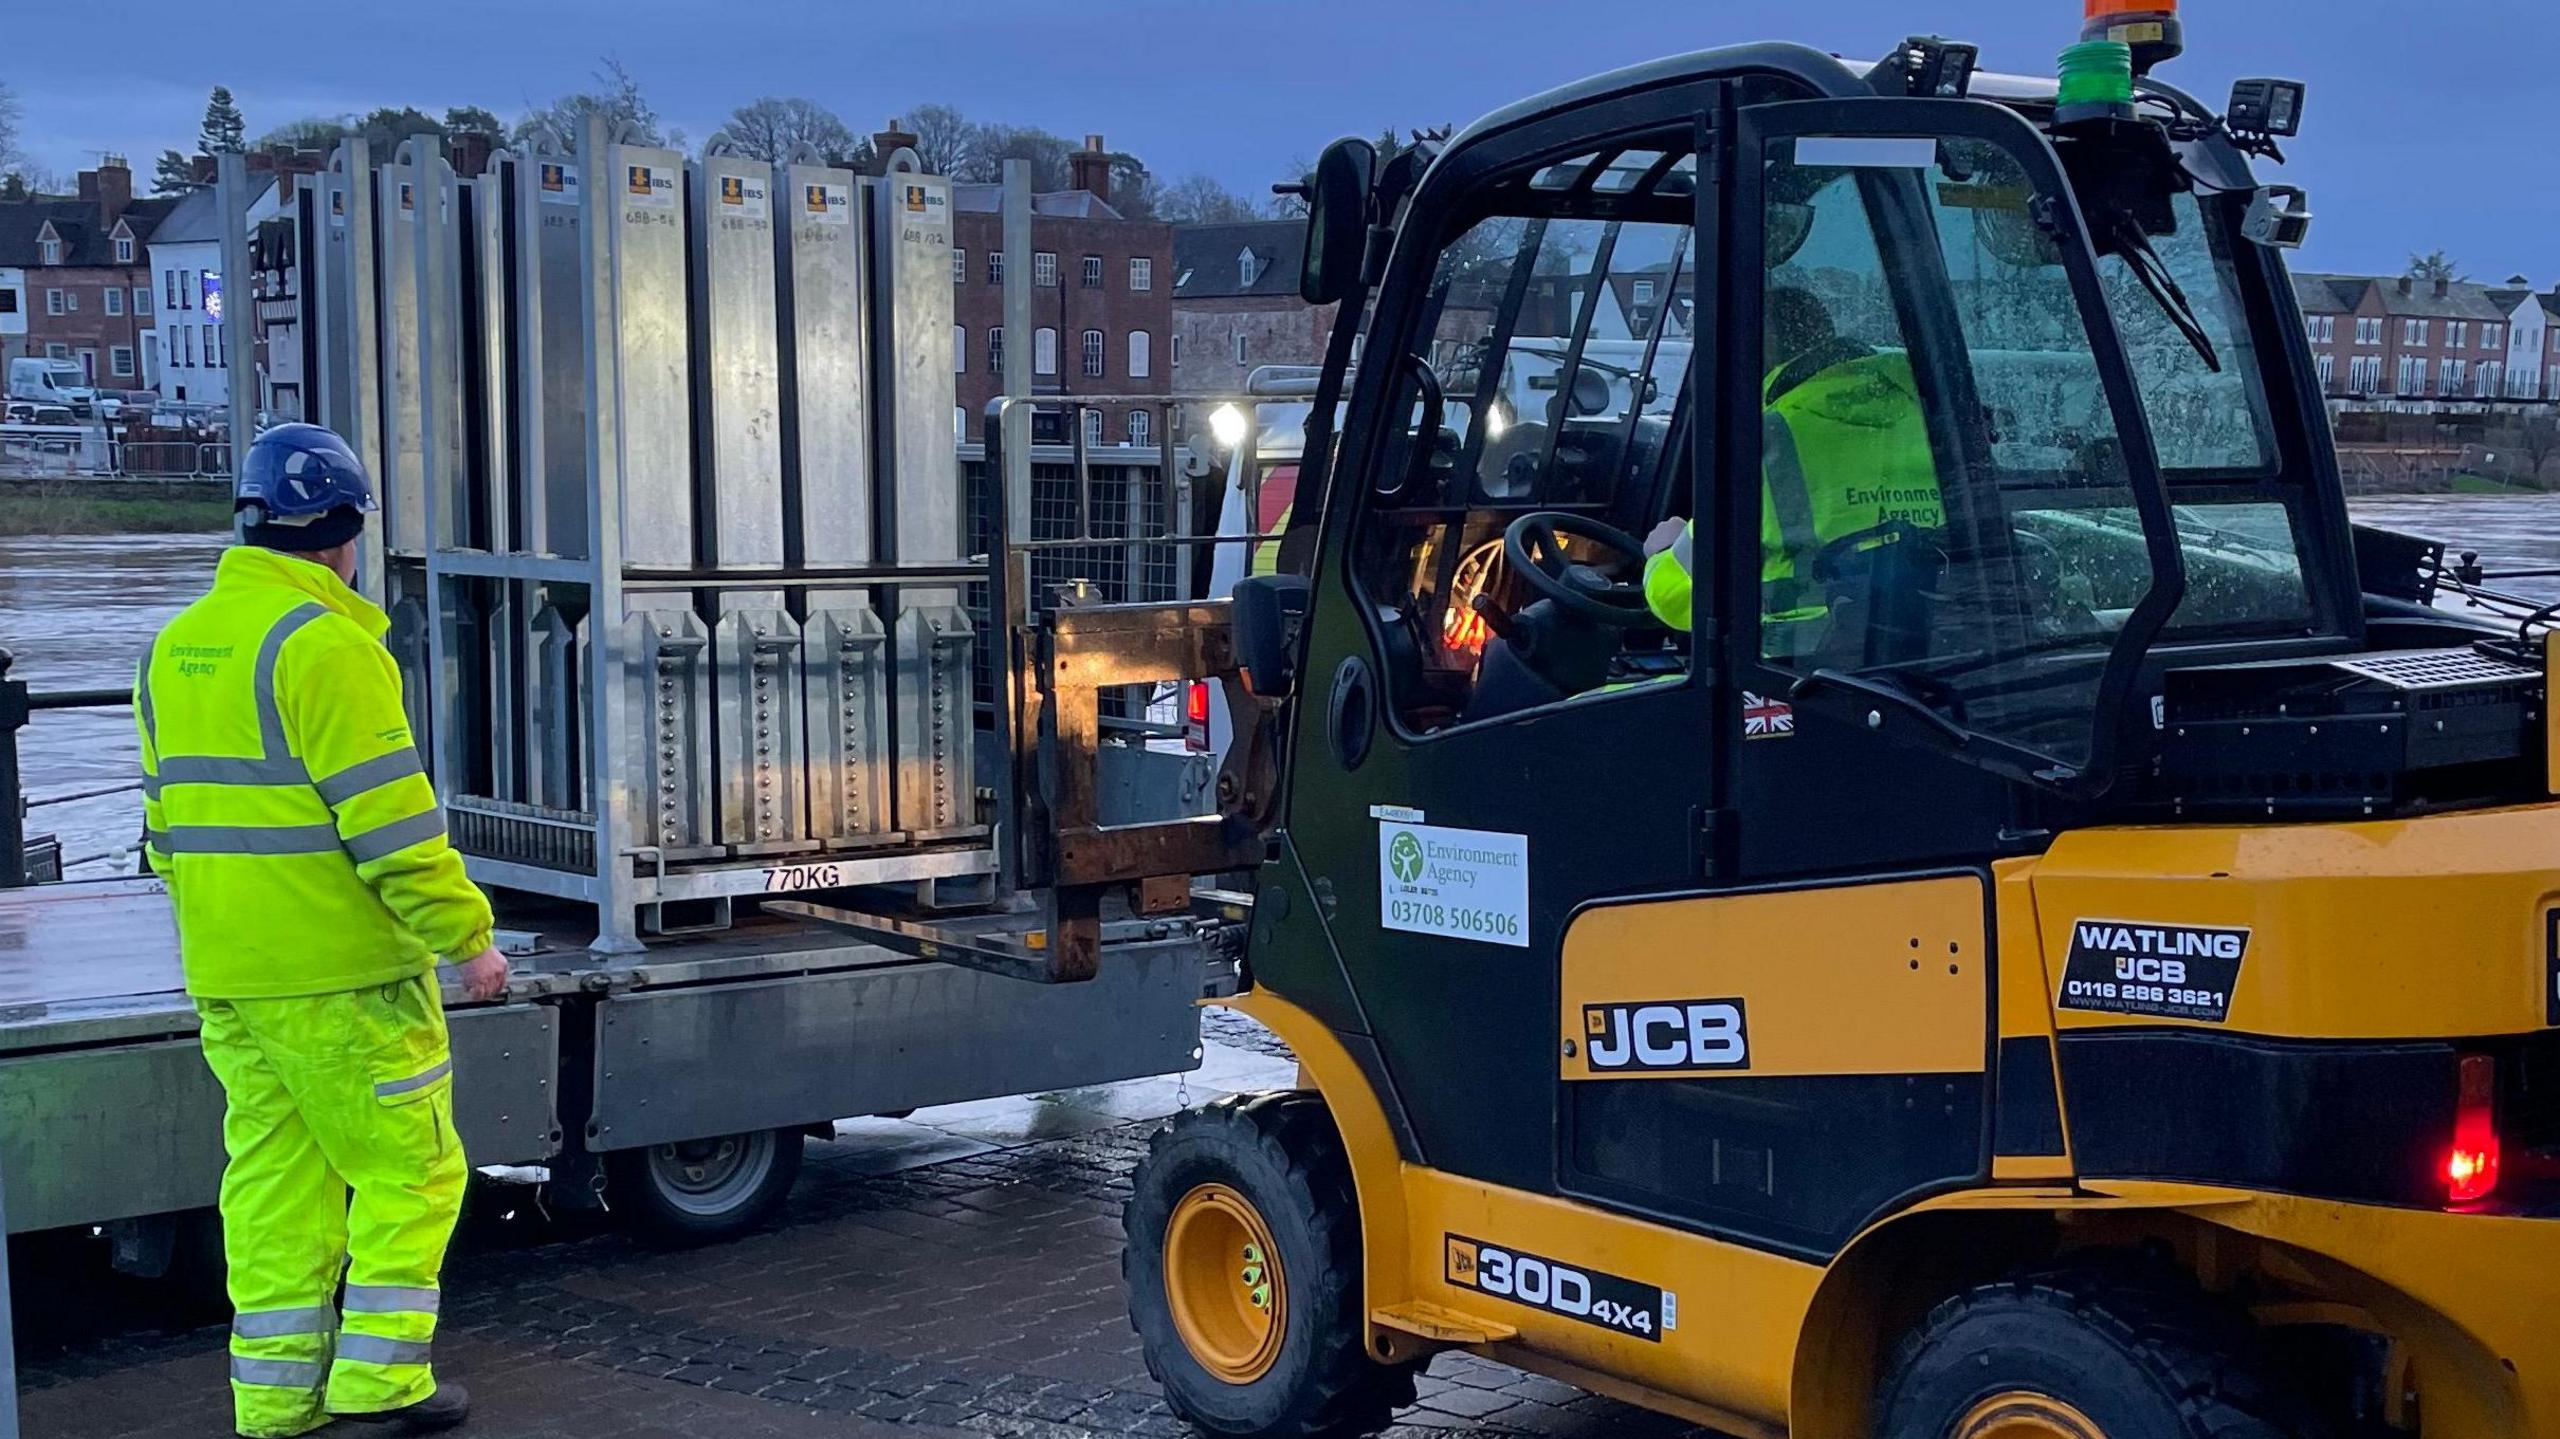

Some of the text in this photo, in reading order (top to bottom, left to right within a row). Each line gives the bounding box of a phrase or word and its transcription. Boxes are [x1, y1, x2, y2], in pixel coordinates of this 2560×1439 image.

[564, 176, 579, 185] IB
[652, 178, 673, 189] IBS
[744, 189, 764, 199] IBS
[828, 196, 847, 206] IBS
[926, 196, 945, 206] IBS
[1846, 485, 1940, 506] Environme
[1879, 506, 1939, 527] Agency
[170, 644, 234, 658] Environment
[179, 659, 217, 678] Agency
[1427, 840, 1519, 867] Environment
[762, 865, 840, 891] 770KG
[1427, 862, 1478, 889] Agency
[1391, 899, 1518, 936] 03708 506506
[2079, 925, 2241, 959] WATLING
[2115, 957, 2187, 984] JCB
[2068, 980, 2224, 1007] 0116 286 3621
[2068, 997, 2224, 1018] WWW.WATLING-JCB.COM
[1589, 1003, 1746, 1067] JCB
[1479, 1247, 1592, 1316] 30D
